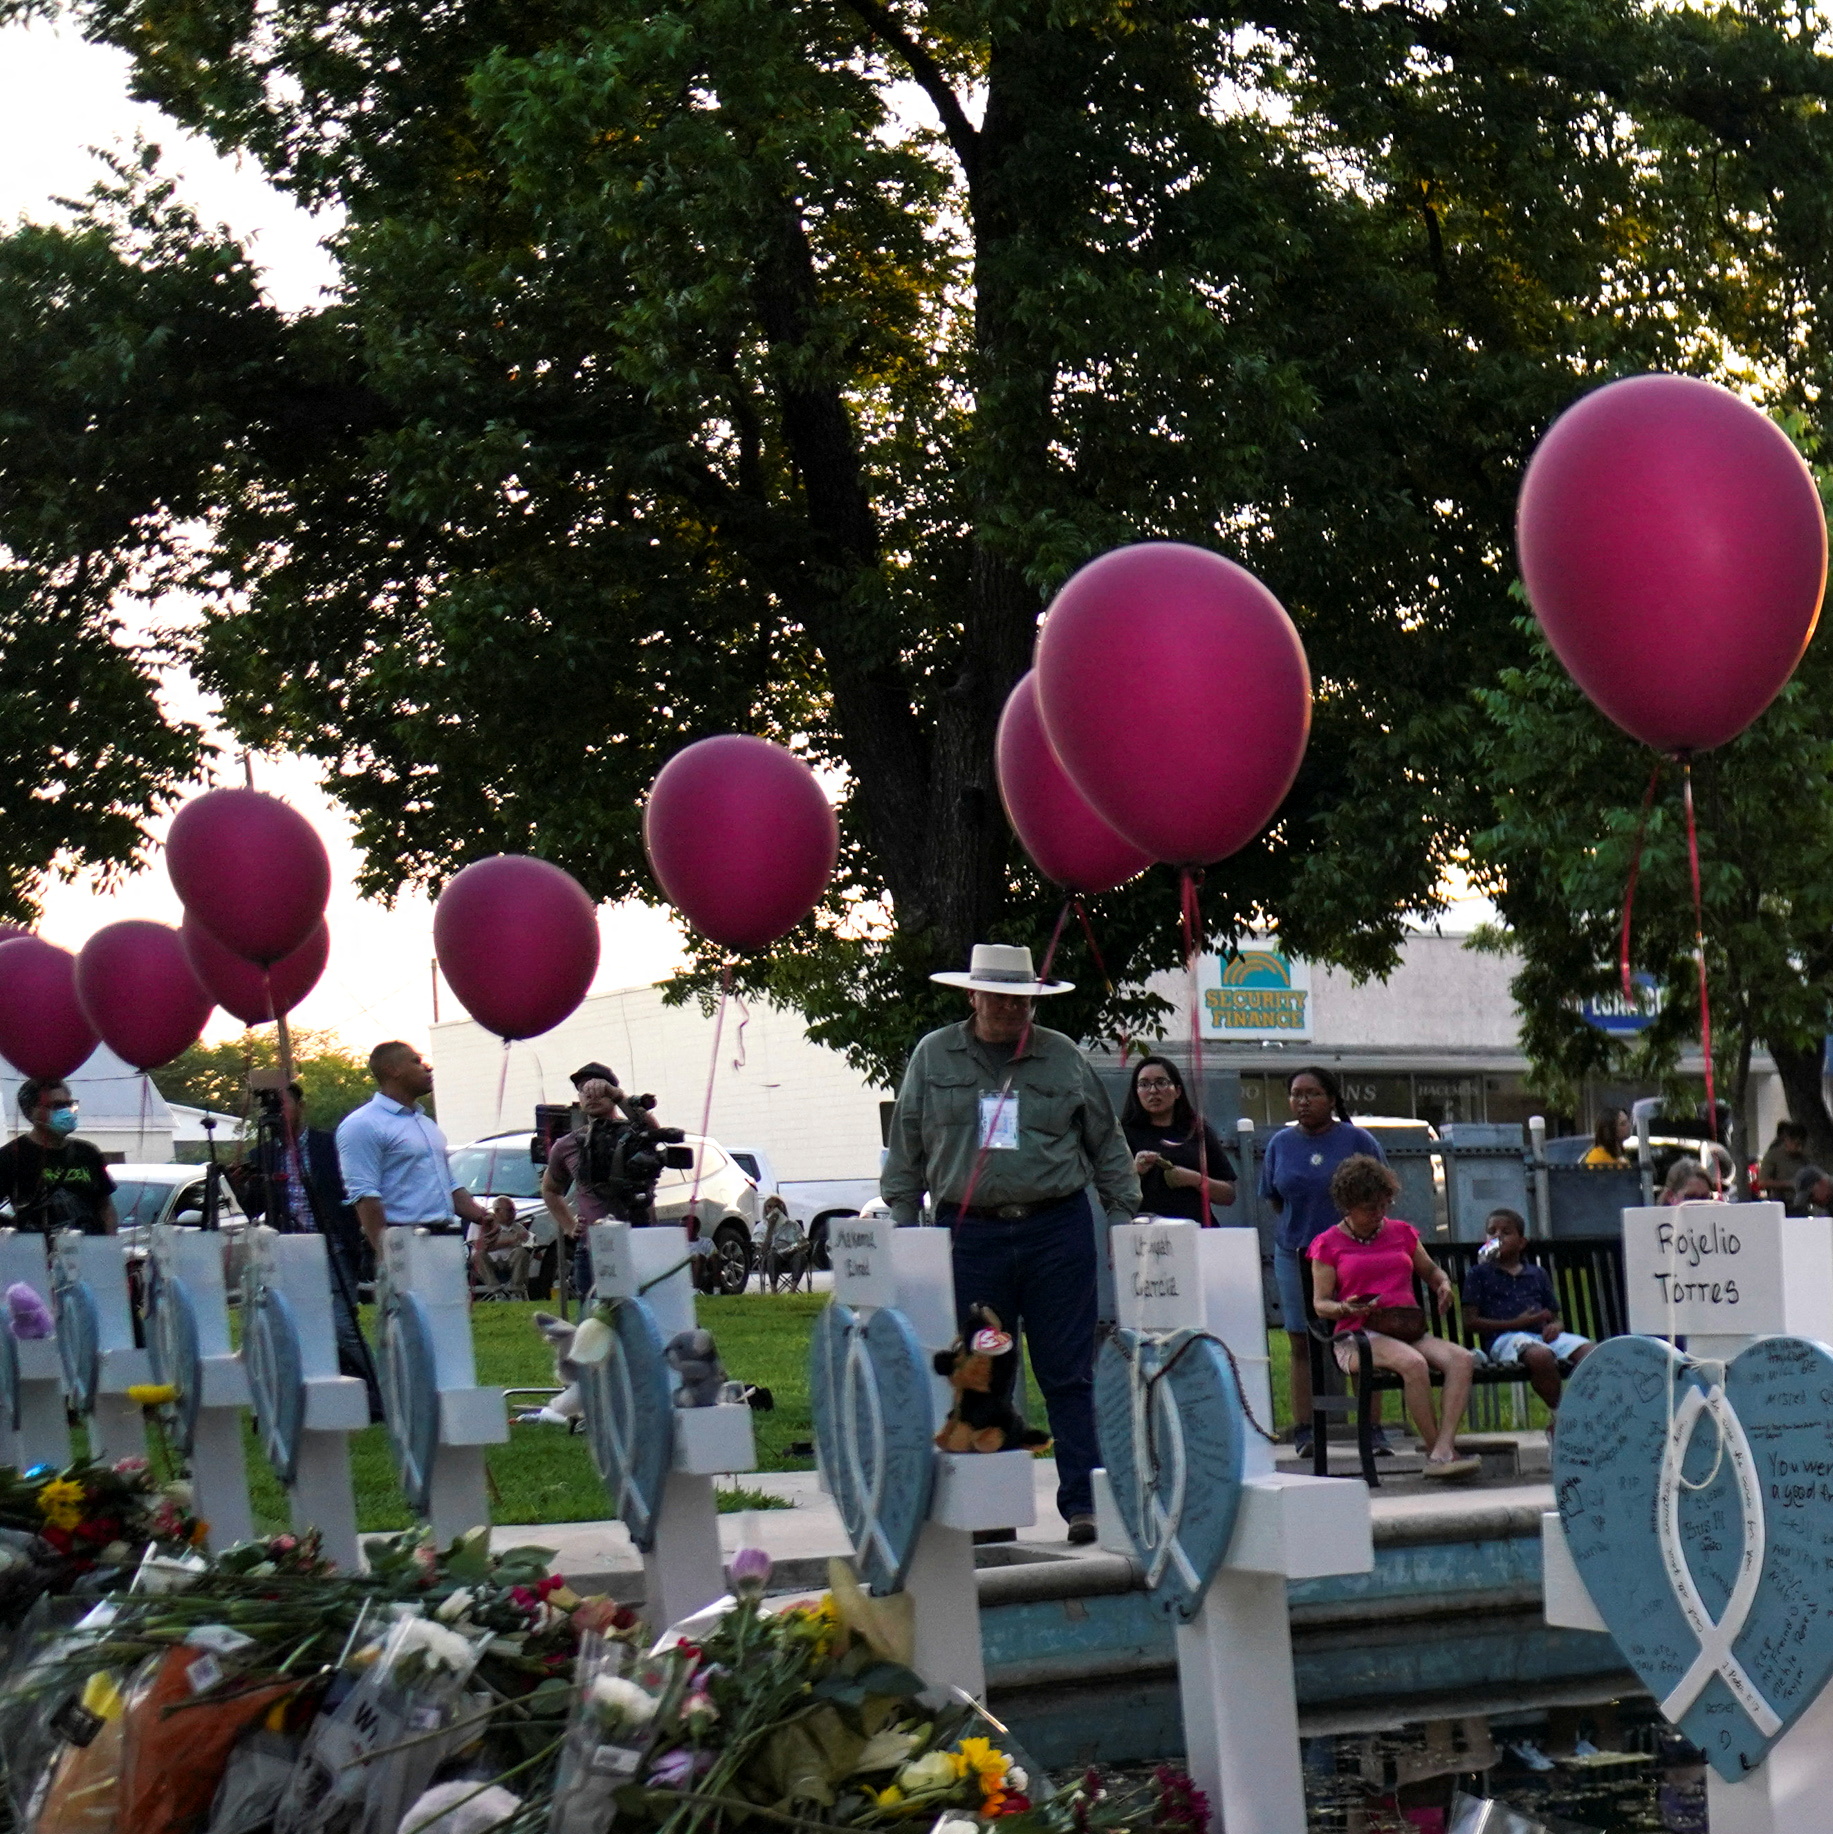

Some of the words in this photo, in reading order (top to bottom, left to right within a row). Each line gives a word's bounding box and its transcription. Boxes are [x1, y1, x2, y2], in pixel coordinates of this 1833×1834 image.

[1205, 989, 1308, 1009] SECURITY
[1212, 1010, 1305, 1029] FINANCE
[1658, 1222, 1741, 1266] Rojelio
[1654, 1273, 1739, 1304] Torres
[1767, 1451, 1799, 1478] You
